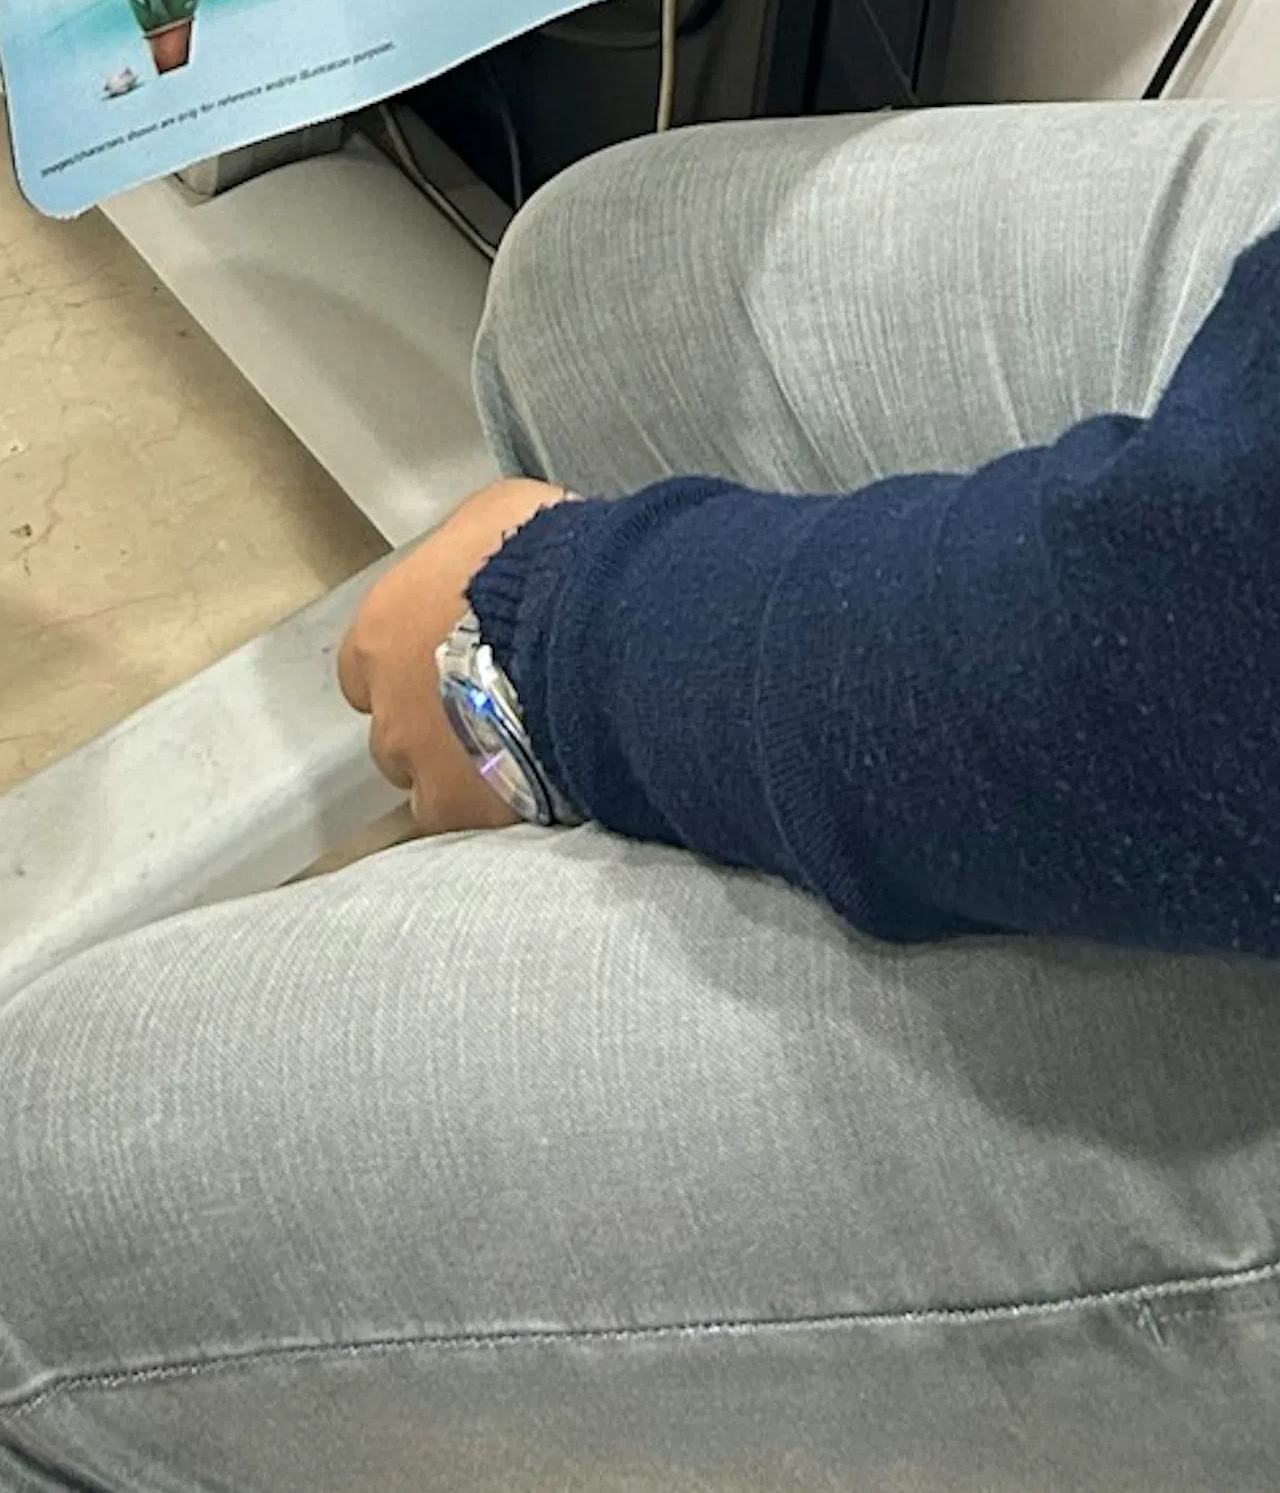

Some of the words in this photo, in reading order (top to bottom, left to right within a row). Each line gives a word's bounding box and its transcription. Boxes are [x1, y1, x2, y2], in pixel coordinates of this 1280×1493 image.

[127, 123, 158, 141] shown
[160, 117, 175, 129] are
[217, 86, 262, 108] reference
